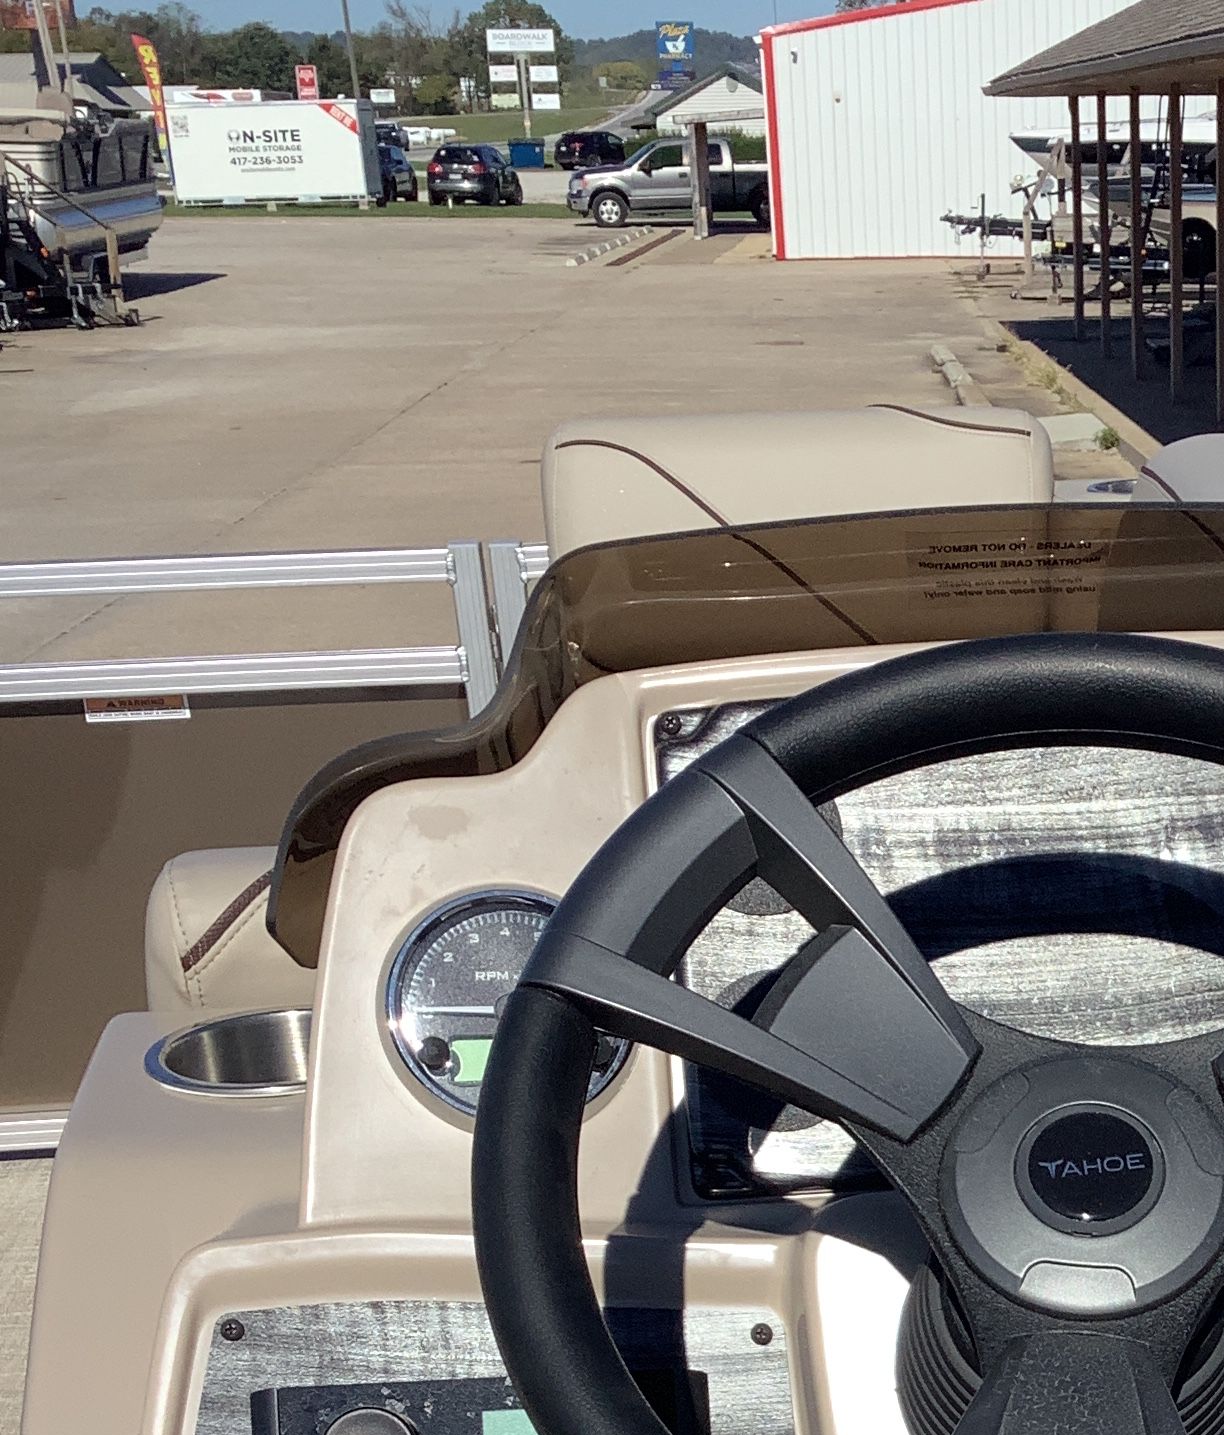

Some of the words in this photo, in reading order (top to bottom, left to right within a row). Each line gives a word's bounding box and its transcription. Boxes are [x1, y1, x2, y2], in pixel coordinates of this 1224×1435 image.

[228, 129, 301, 143] ON-SITE
[229, 145, 260, 153] MOBILE
[262, 144, 302, 152] STORAGE
[230, 155, 304, 165] 417-236-3053
[500, 927, 510, 936] 4
[468, 933, 480, 943] 3
[443, 952, 454, 962] 2
[475, 971, 509, 981] RPM
[1038, 1153, 1145, 1179] TAHOE
